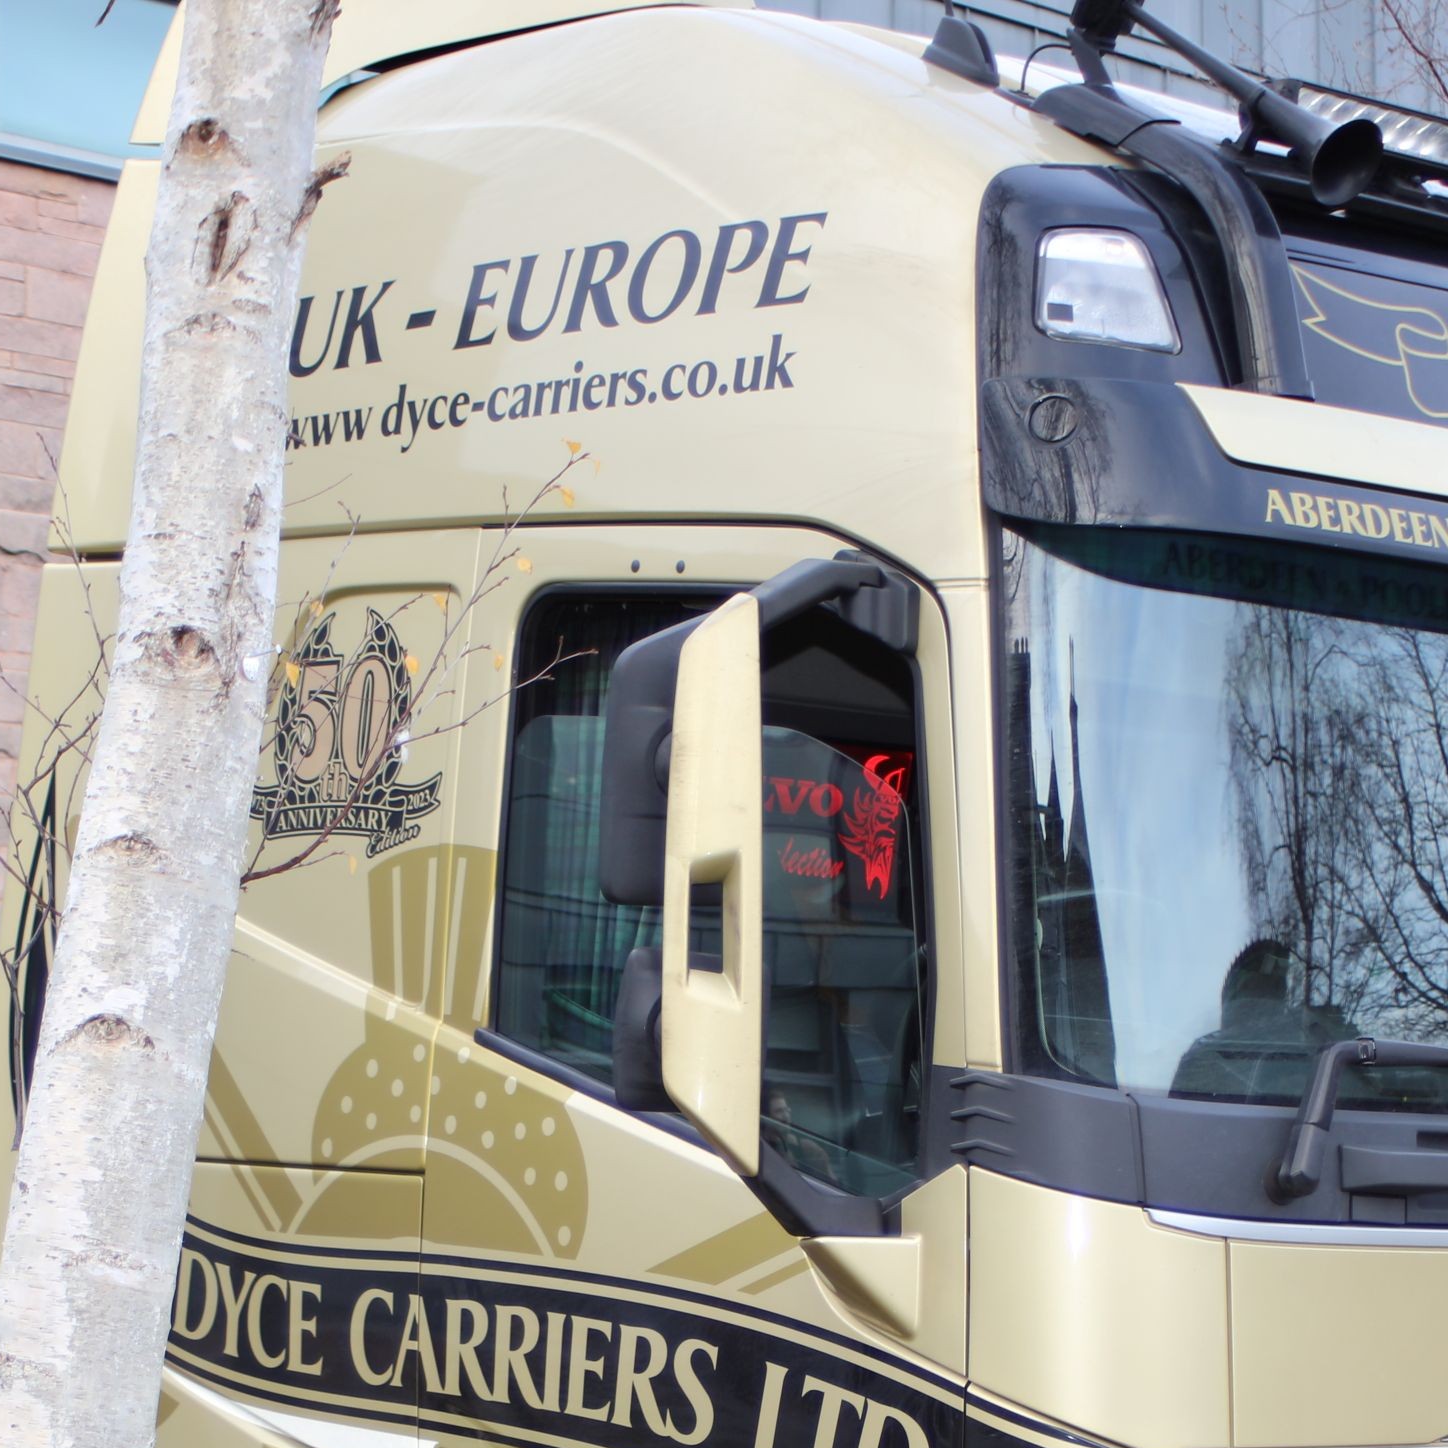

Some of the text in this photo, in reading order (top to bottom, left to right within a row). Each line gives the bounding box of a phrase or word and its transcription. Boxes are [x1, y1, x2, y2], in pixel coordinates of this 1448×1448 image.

[289, 279, 395, 378] UK
[453, 212, 828, 350] EUROPE
[289, 654, 393, 784] 50
[276, 807, 393, 832] ANNIVERSARY
[320, 761, 350, 801] th
[407, 789, 431, 811] 2023
[172, 1246, 323, 1376] DYCE
[350, 1284, 719, 1446] CARRIERS
